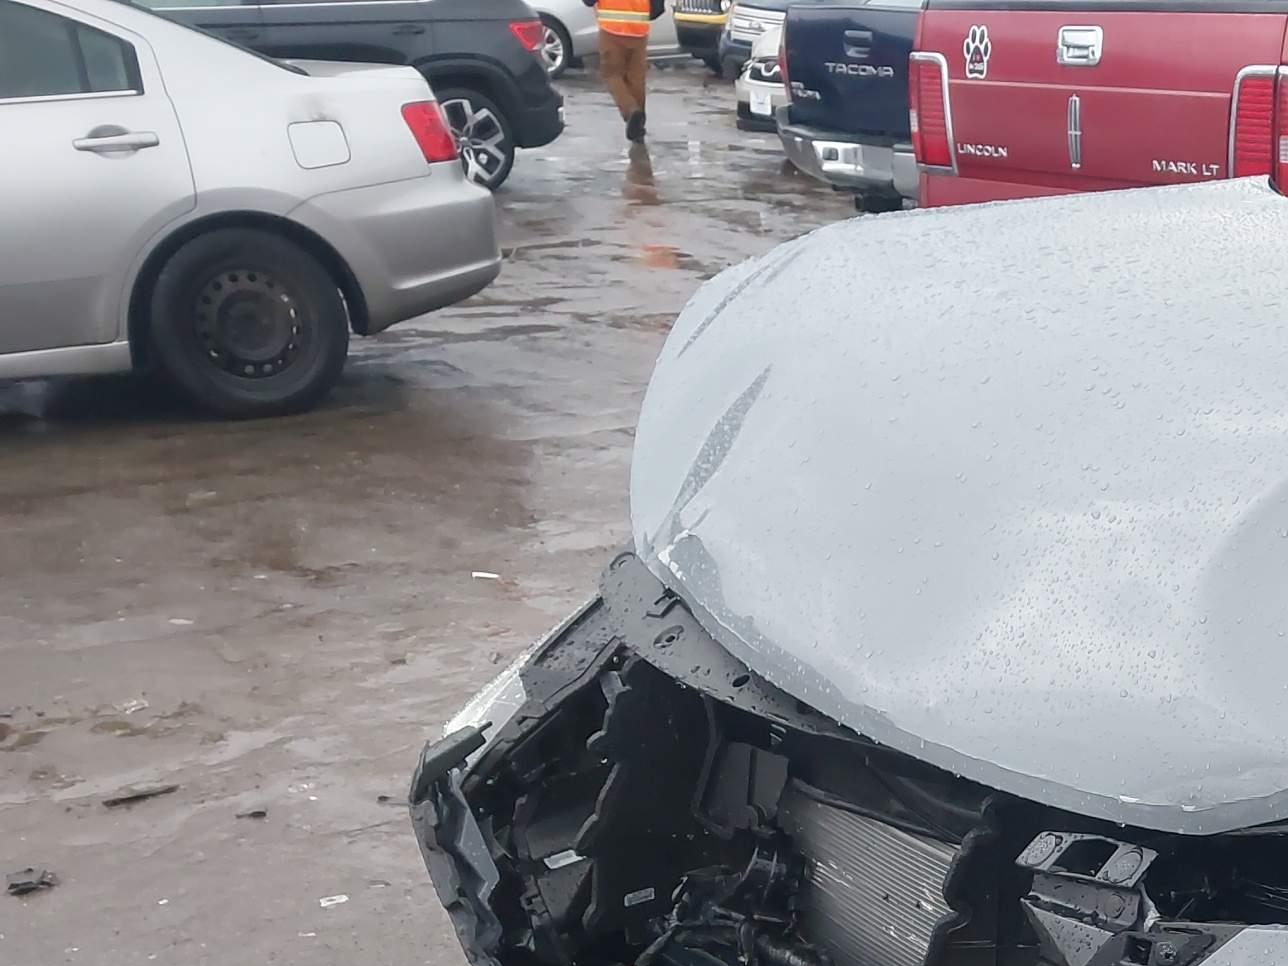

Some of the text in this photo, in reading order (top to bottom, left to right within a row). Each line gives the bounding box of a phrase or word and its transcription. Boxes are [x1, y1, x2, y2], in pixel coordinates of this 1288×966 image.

[824, 62, 894, 77] TACOMA
[957, 143, 1008, 157] LINCOLN
[1152, 160, 1219, 176] MARK LT
